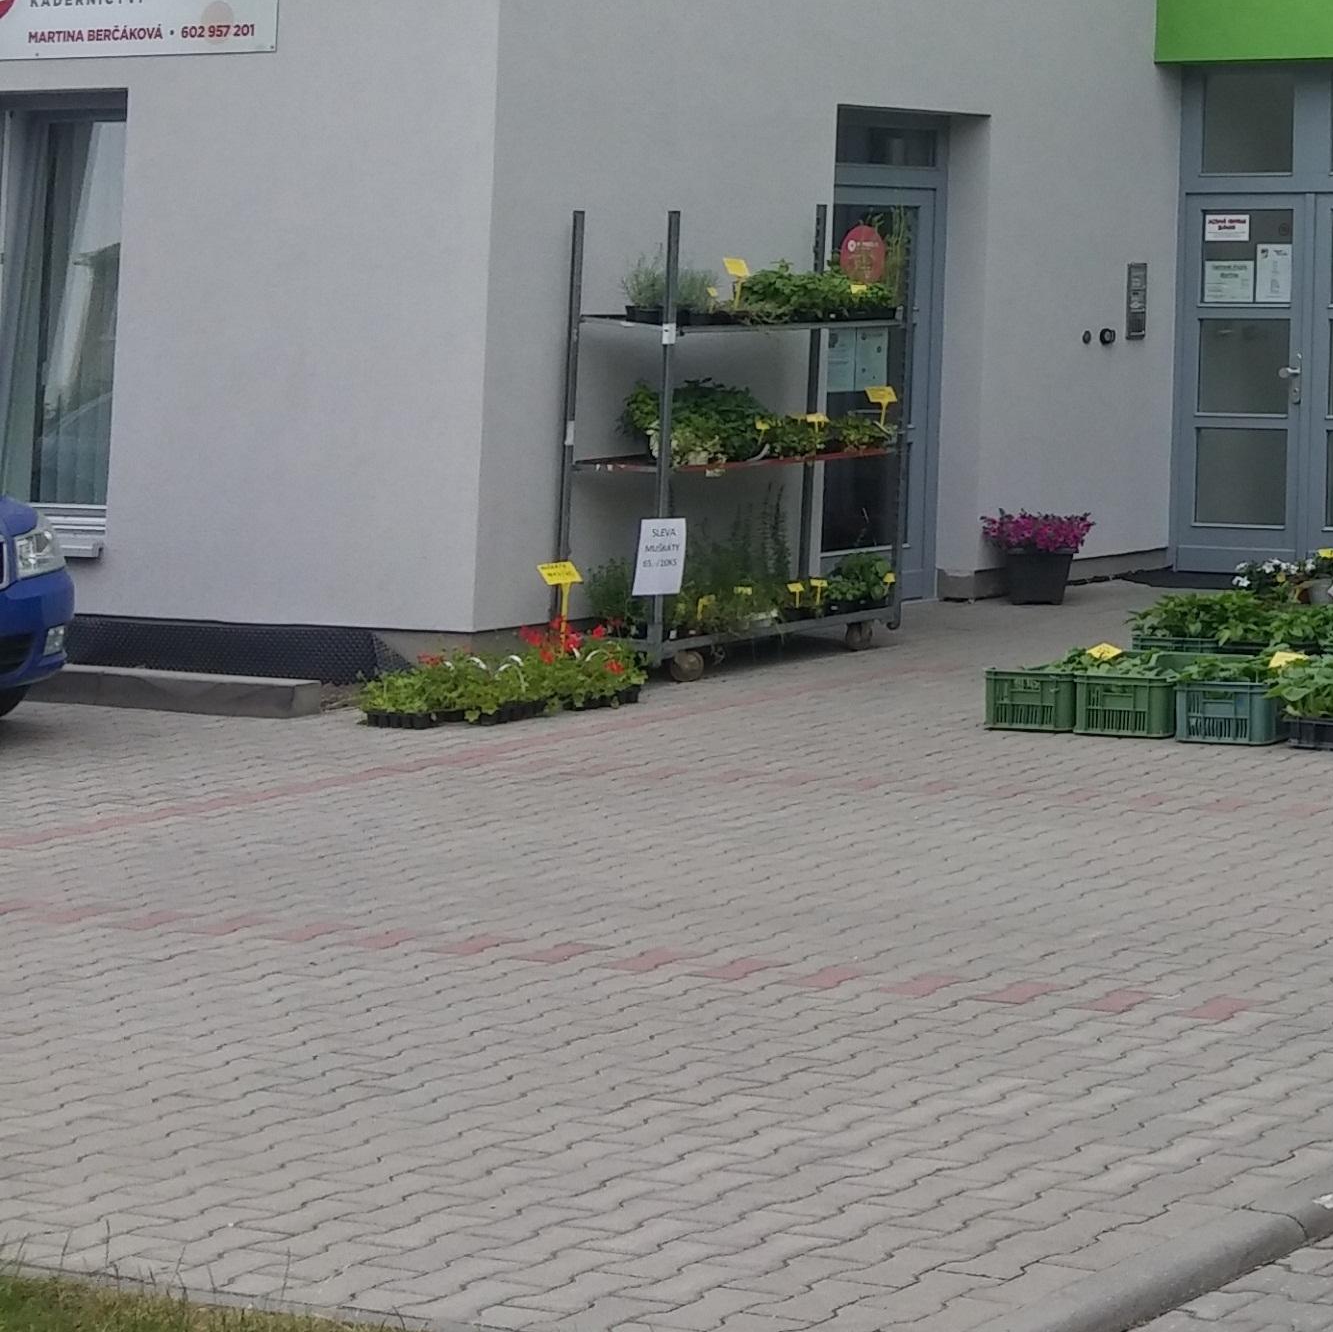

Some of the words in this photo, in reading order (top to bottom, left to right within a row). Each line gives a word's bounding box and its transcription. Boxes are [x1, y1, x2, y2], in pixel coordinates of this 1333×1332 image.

[27, 29, 85, 44] MARTINA
[87, 23, 164, 42] BERČÁKOVÁ
[180, 25, 205, 38] 602
[207, 24, 231, 38] 957
[232, 23, 255, 37] 201
